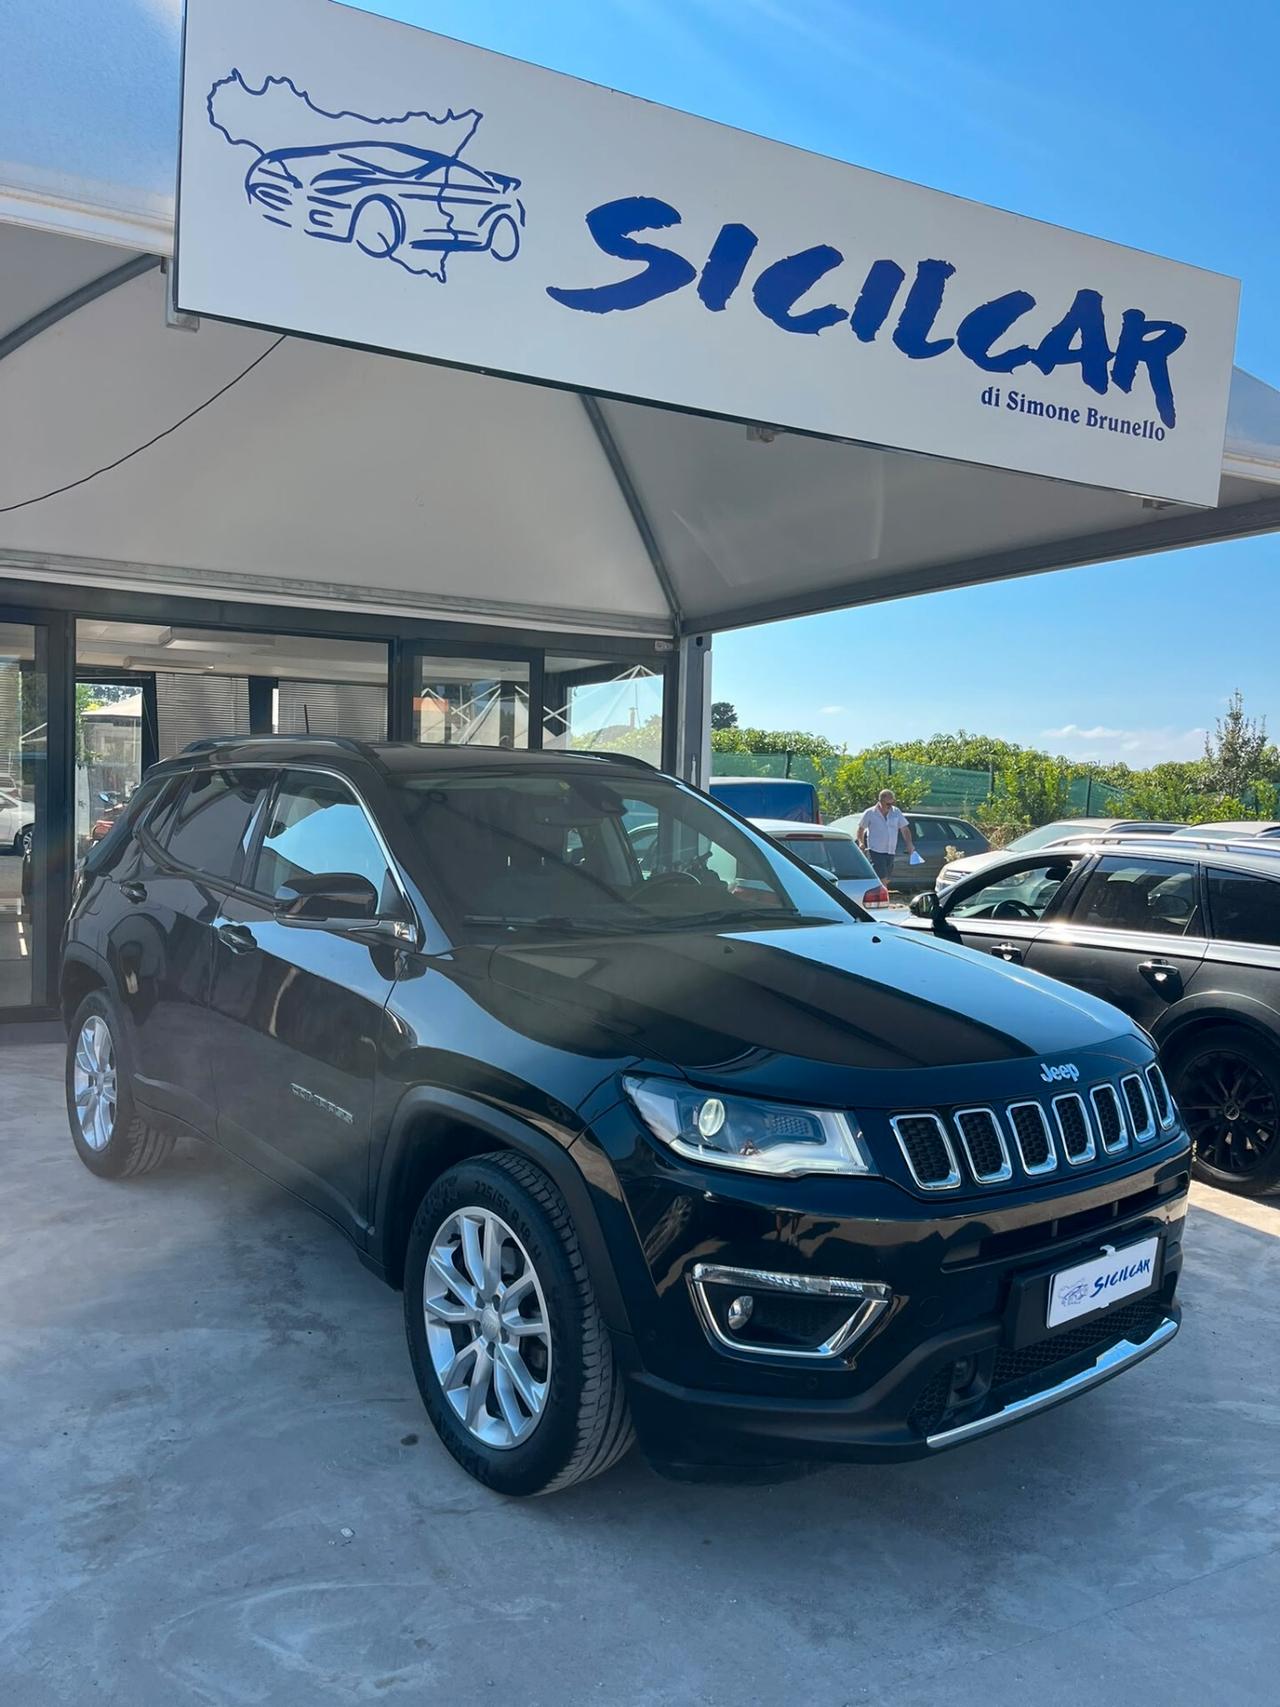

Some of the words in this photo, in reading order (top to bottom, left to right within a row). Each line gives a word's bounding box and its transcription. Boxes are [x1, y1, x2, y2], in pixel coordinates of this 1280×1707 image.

[546, 195, 1188, 430] SICILCAR
[981, 386, 1001, 408] di
[1006, 390, 1081, 424] Simone
[1085, 407, 1166, 442] Brunello
[1040, 1063, 1080, 1082] Jeep
[1089, 1258, 1151, 1298] SICILCAR
